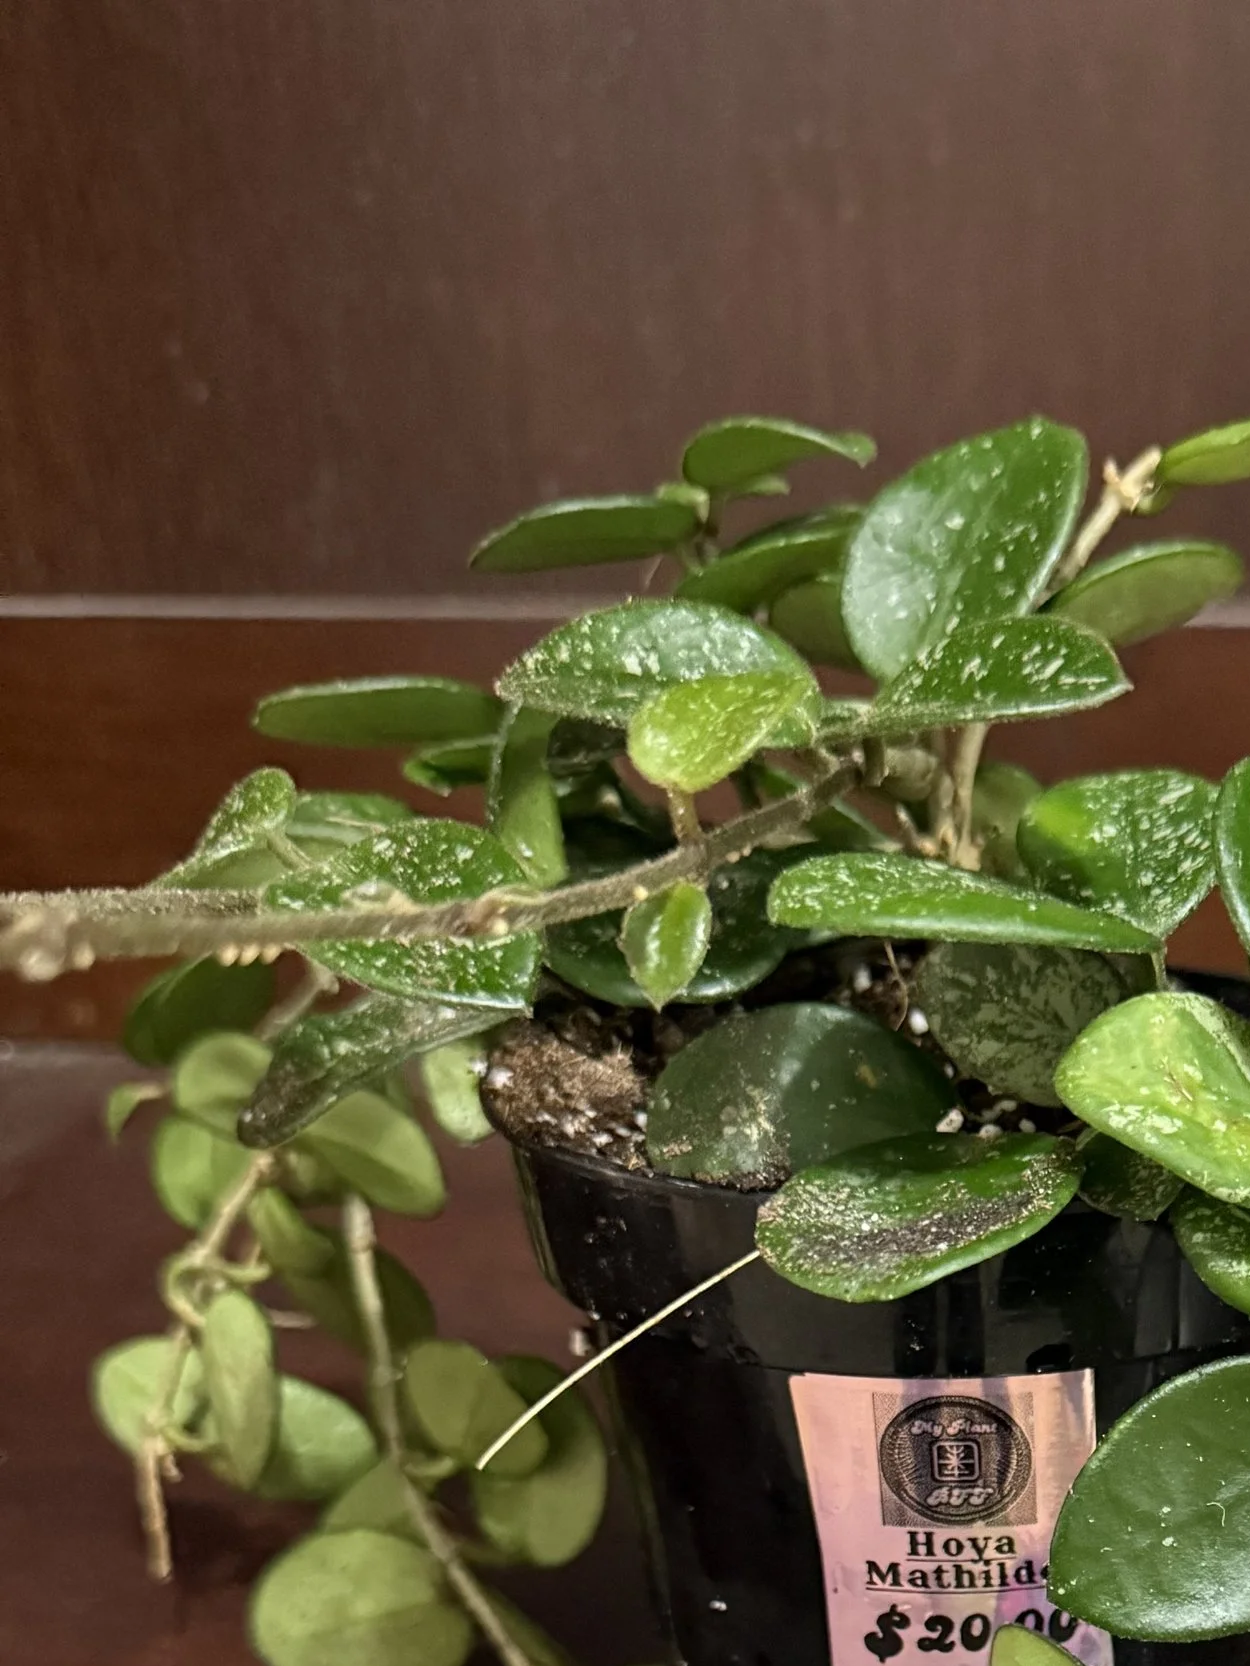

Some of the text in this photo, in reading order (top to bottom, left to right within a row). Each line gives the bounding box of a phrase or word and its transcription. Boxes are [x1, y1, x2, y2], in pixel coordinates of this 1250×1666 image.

[910, 1417, 998, 1437] My Plant
[906, 1531, 1016, 1564] Hoya
[863, 1603, 1078, 1664] $200
